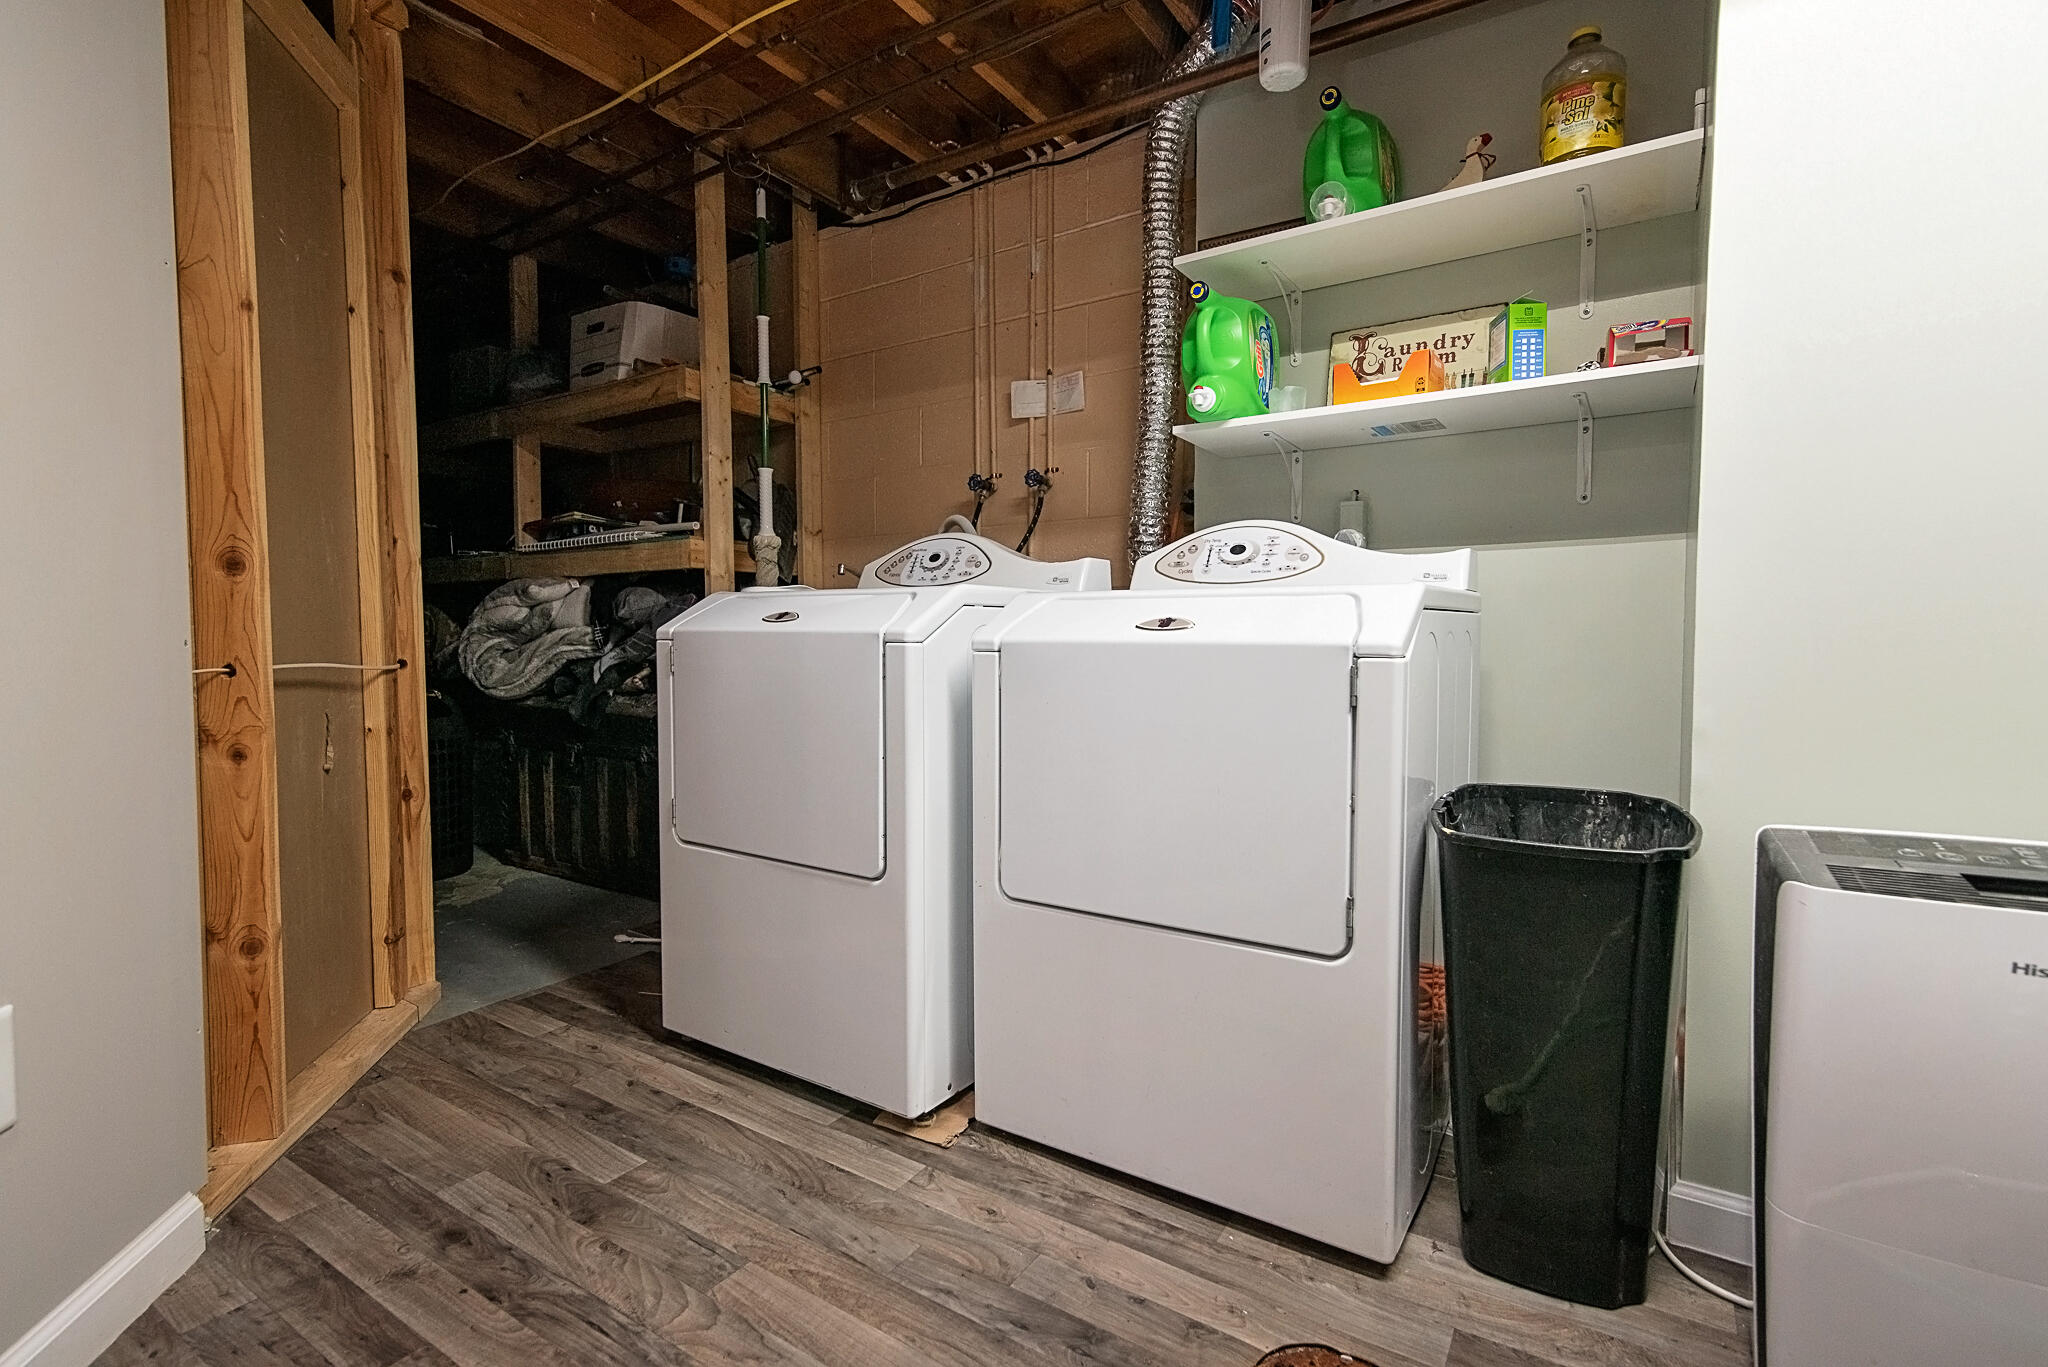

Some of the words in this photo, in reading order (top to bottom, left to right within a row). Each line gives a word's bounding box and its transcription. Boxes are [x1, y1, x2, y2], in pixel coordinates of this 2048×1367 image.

[1562, 95, 1596, 114] Pine
[1255, 339, 1264, 378] Gain
[1349, 331, 1476, 378] Laundry
[1391, 351, 1457, 373] Rm
[2011, 961, 2048, 978] His
